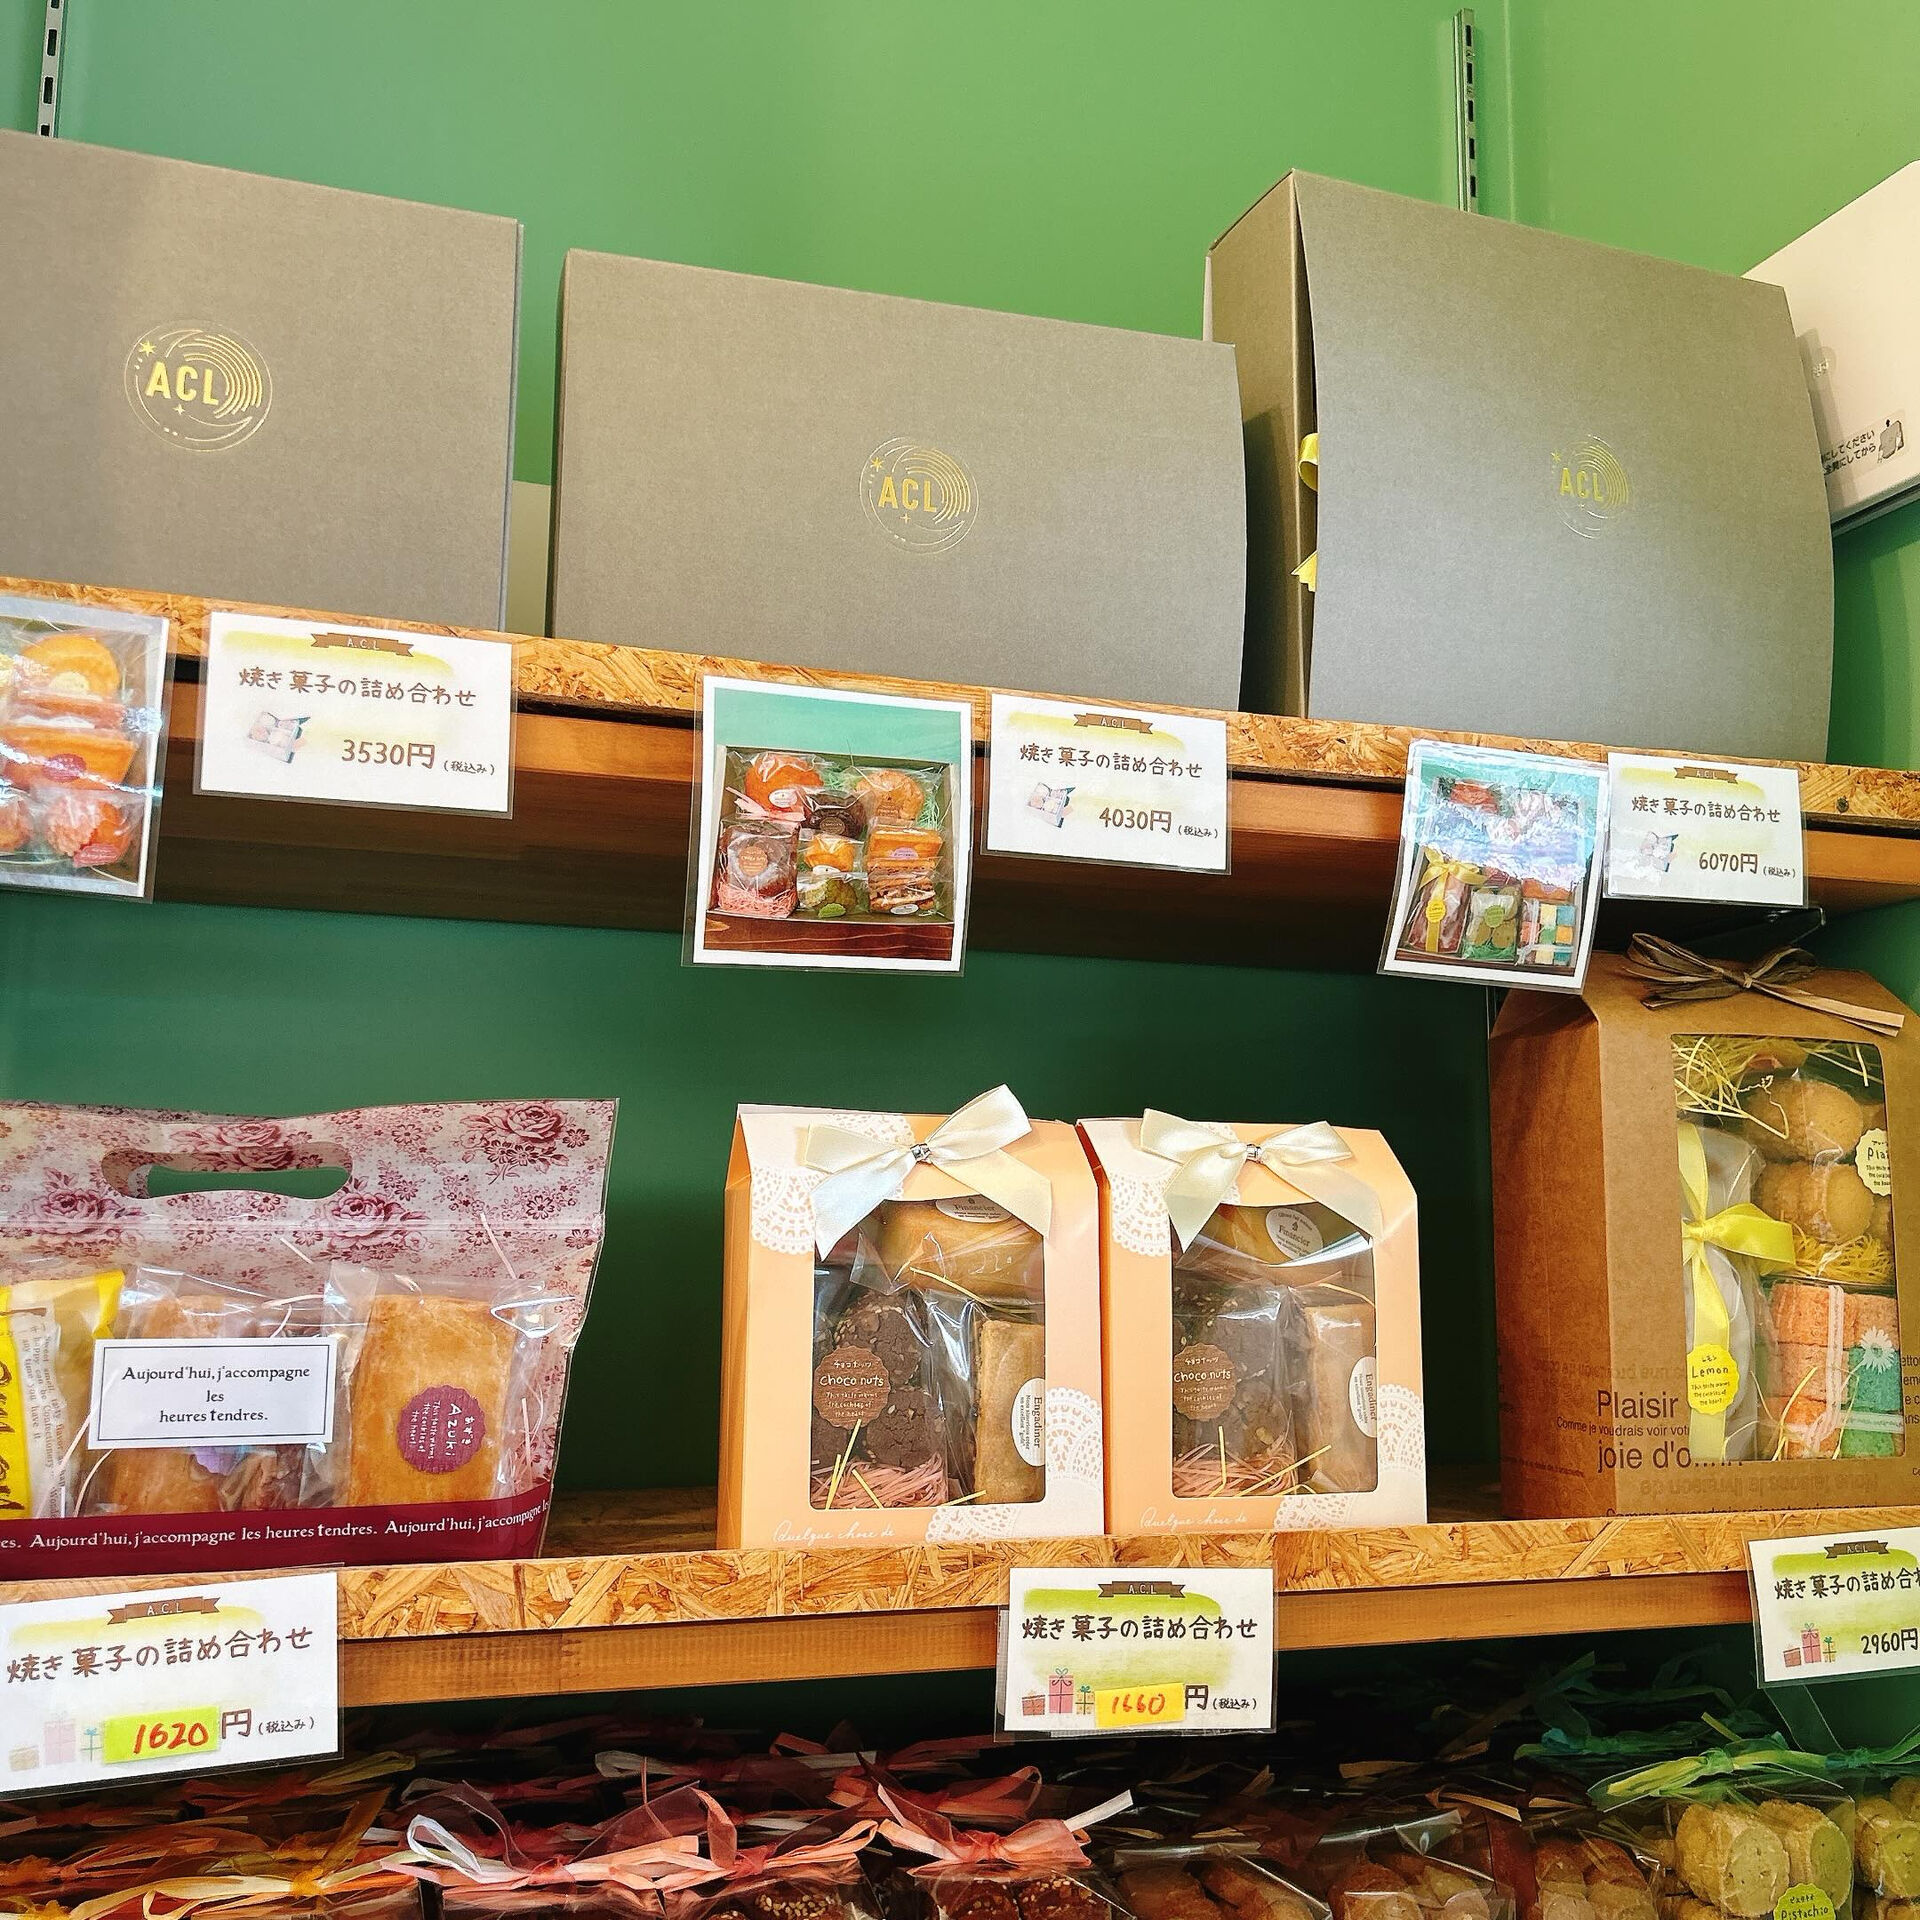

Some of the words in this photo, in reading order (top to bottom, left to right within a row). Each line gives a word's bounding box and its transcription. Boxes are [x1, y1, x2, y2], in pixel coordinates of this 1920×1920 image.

[145, 361, 219, 406] ACL
[1821, 430, 1875, 462] にしてください
[878, 475, 937, 512] ACL
[1560, 467, 1604, 501] ACL
[341, 739, 436, 769] 3530円
[1099, 807, 1172, 833] 4030円
[1699, 852, 1758, 874] 6070円
[1868, 1147, 1889, 1160] Plai
[860, 1374, 884, 1387] nuts
[1209, 1369, 1231, 1380] nuts
[1692, 1366, 1729, 1378] Lemon
[206, 1390, 225, 1402] les
[1596, 1389, 1679, 1419] Plaisir
[160, 1410, 206, 1423] heures
[210, 1408, 268, 1422] tendres.
[444, 1403, 462, 1456] Azuki
[1031, 1396, 1044, 1449] Engadiner
[1556, 1416, 1587, 1431] Comme
[1599, 1425, 1644, 1437] voudrais
[1646, 1425, 1668, 1437] voir
[1596, 1439, 1643, 1474] joie
[241, 1526, 261, 1541] les
[265, 1525, 314, 1539] heures
[317, 1522, 378, 1537] tendres.
[880, 1523, 895, 1537] de
[1860, 1627, 1919, 1655] 2960円
[1111, 1692, 1165, 1715] 1660
[1184, 1684, 1209, 1711] 円
[132, 1722, 209, 1754] 1620
[221, 1708, 252, 1739] 円
